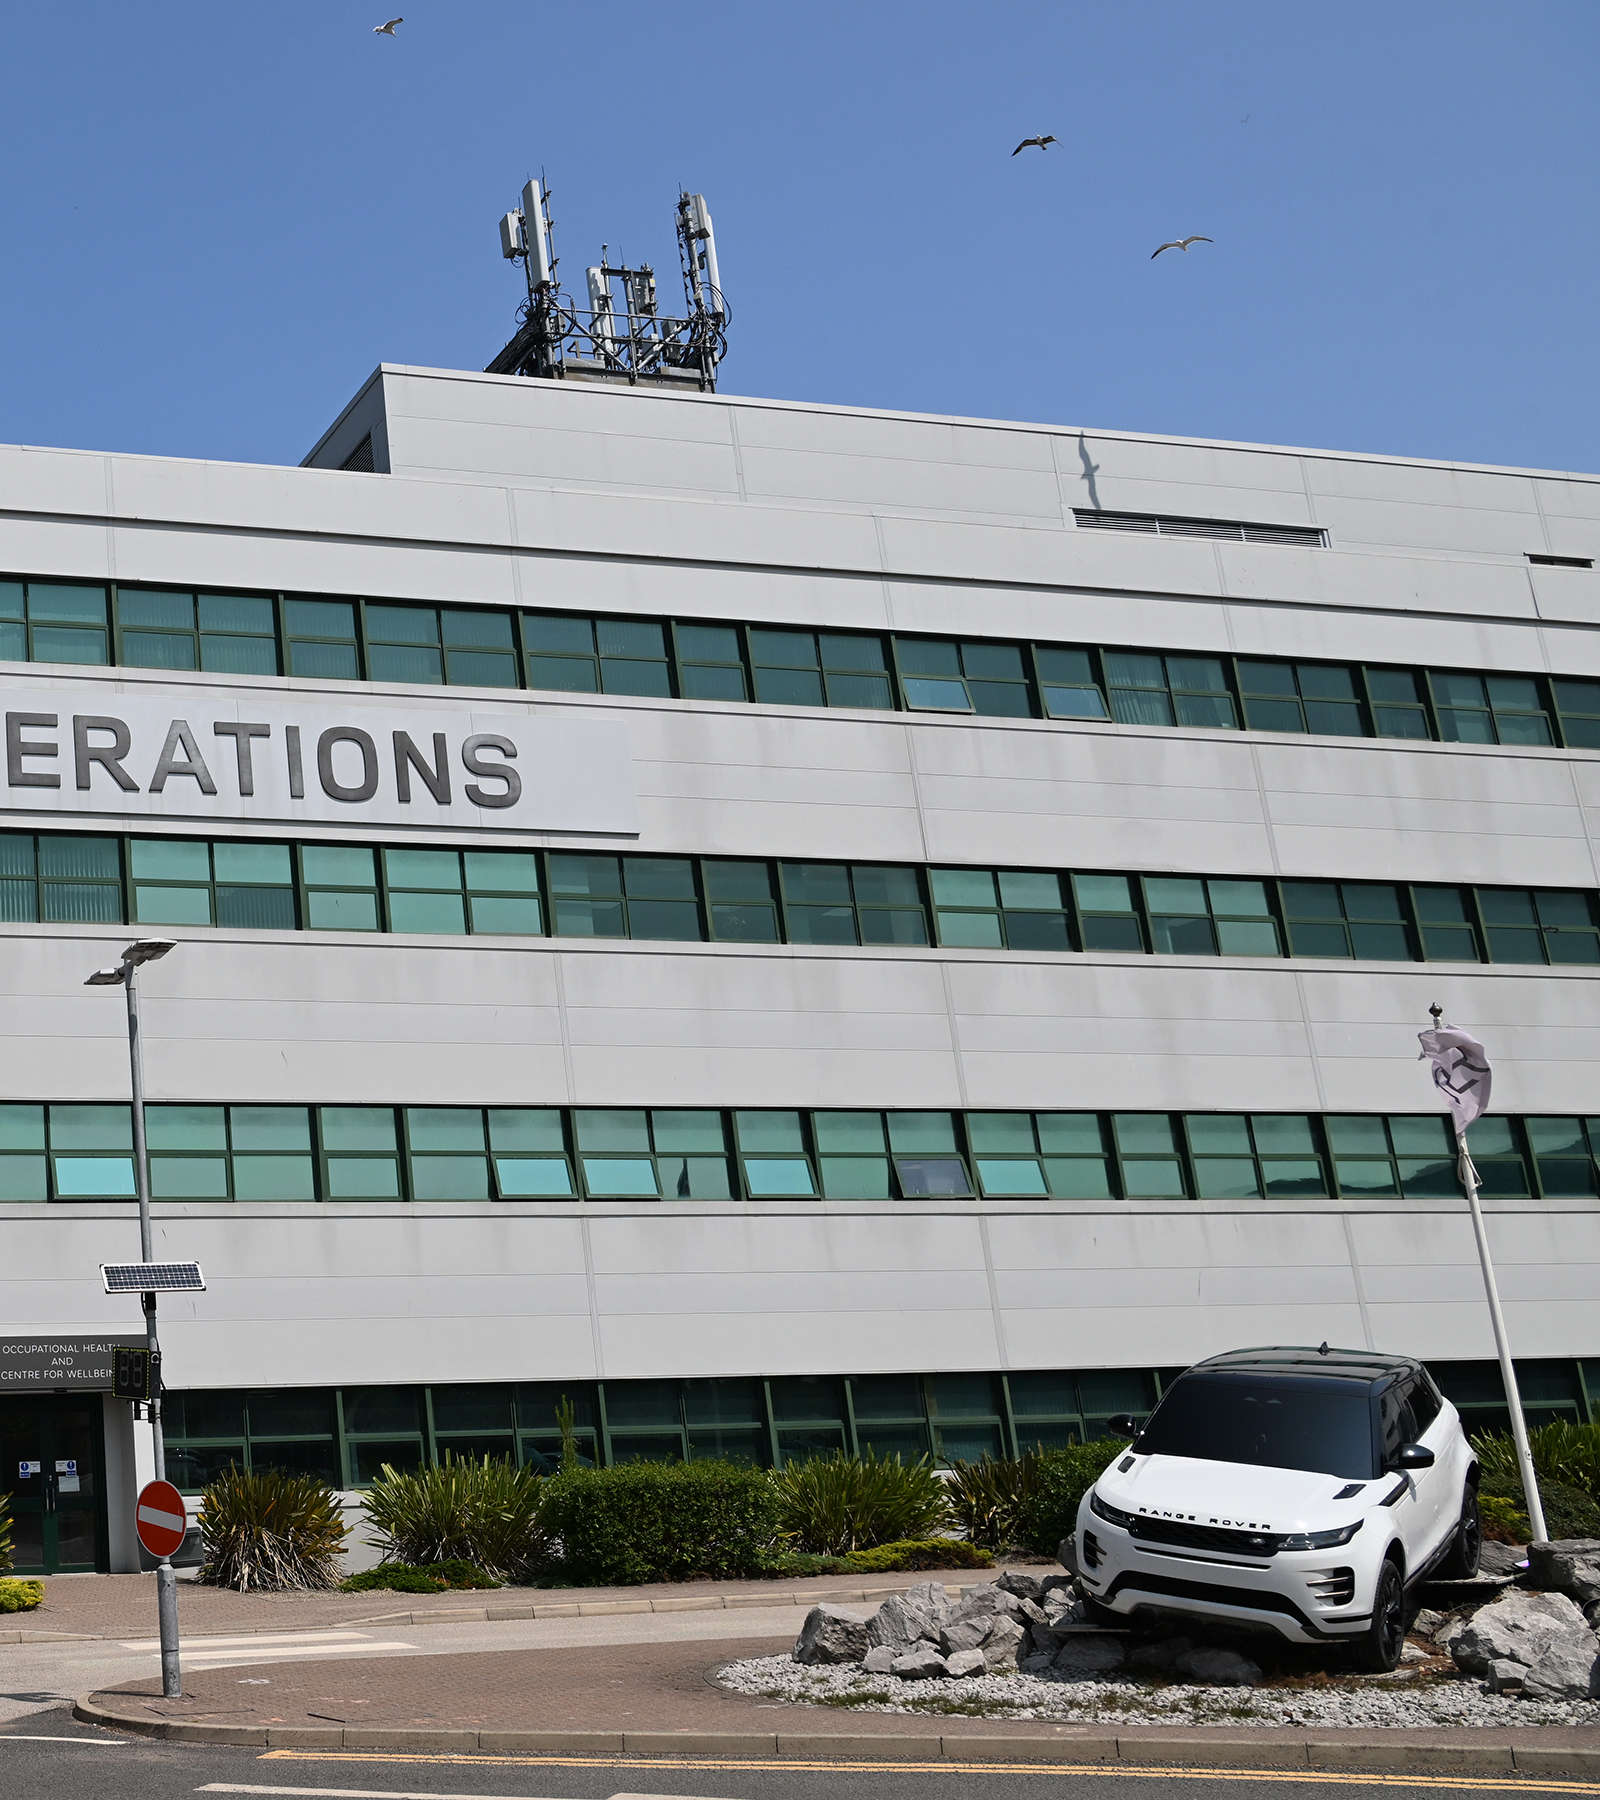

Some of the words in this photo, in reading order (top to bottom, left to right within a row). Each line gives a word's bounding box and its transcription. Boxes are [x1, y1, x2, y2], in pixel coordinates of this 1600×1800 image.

[2, 1344, 80, 1355] OCCUPATIONAL
[83, 1343, 120, 1353] HEALT
[51, 1357, 74, 1366] AND
[0, 1370, 40, 1380] CENTRE
[44, 1369, 64, 1379] FOR
[66, 1369, 114, 1379] WELLBEIN
[1138, 1506, 1196, 1522] RANGE
[1209, 1517, 1271, 1531] ROVER
